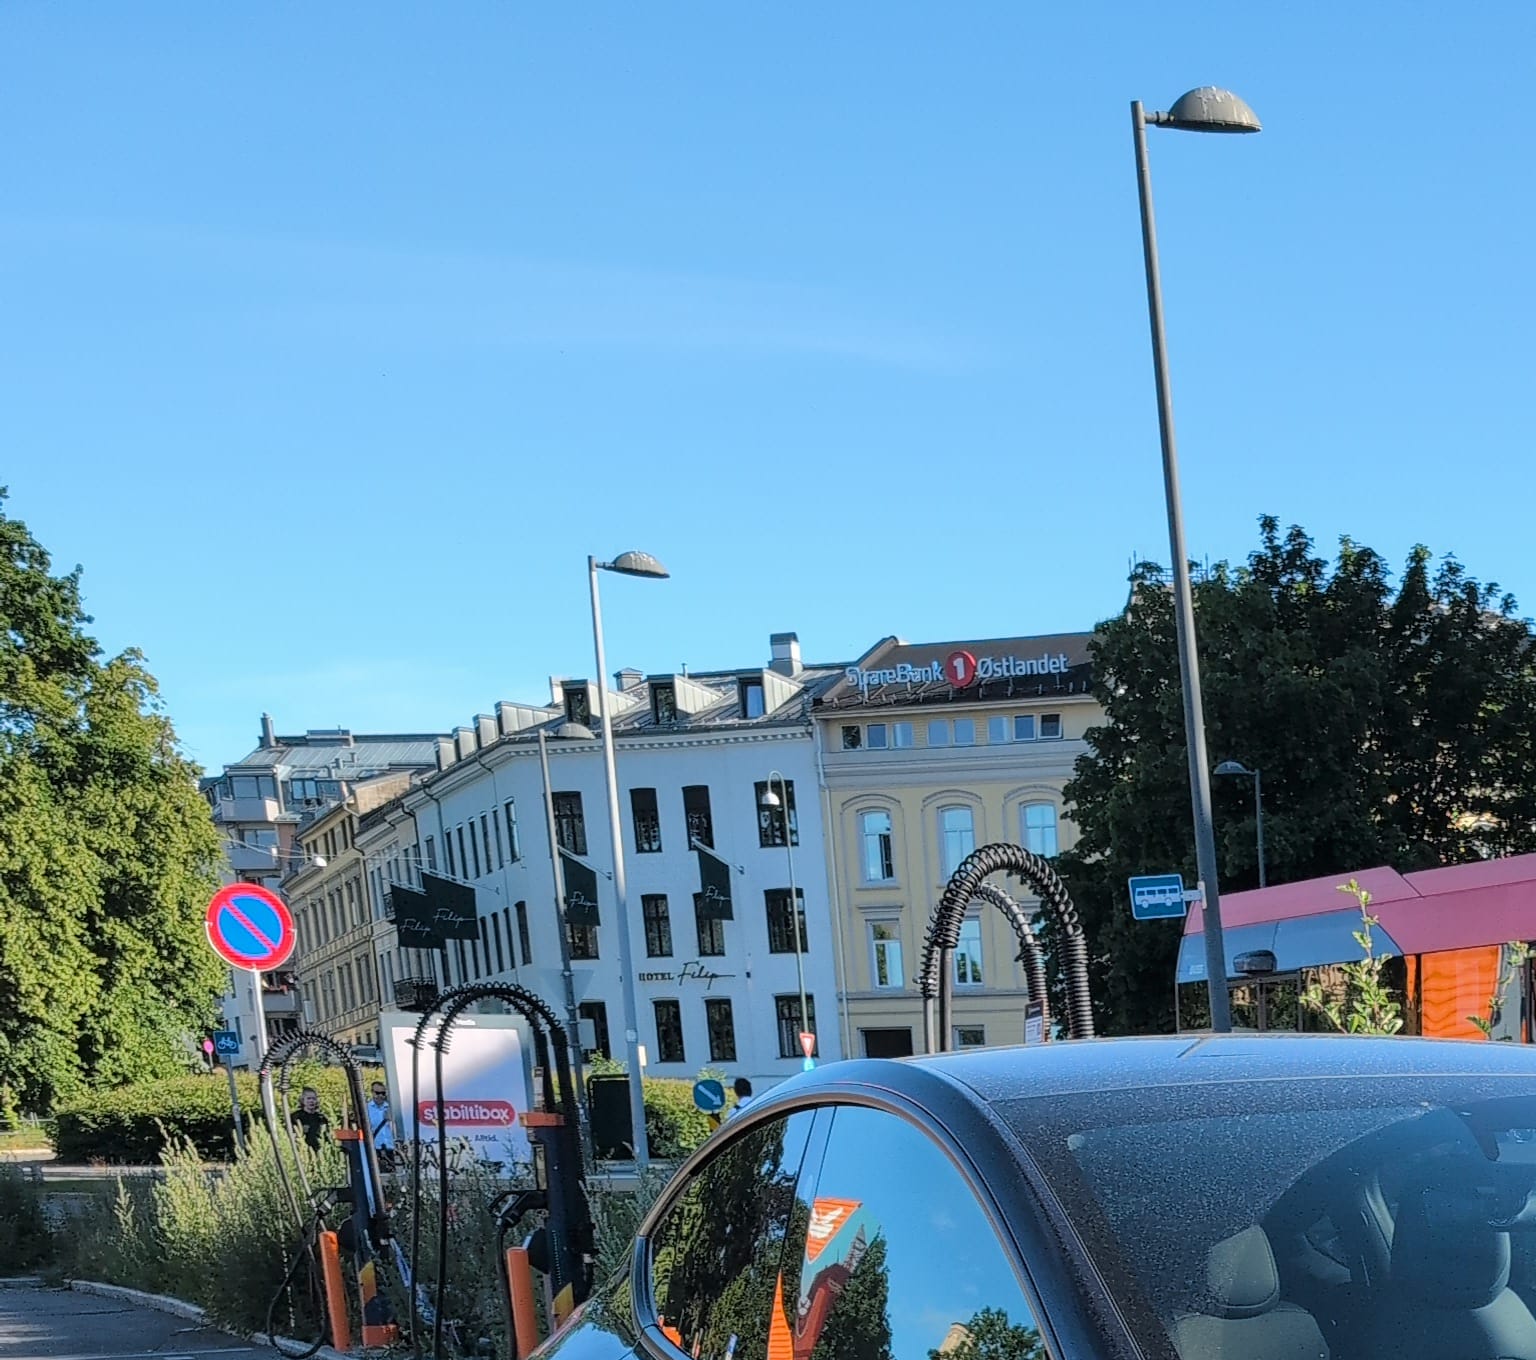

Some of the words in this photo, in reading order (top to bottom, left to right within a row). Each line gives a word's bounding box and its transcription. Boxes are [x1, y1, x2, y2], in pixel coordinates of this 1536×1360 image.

[845, 660, 943, 691] SpareBank
[952, 657, 965, 681] 1
[977, 653, 1069, 678] Østlandet
[638, 971, 674, 981] HOTEL
